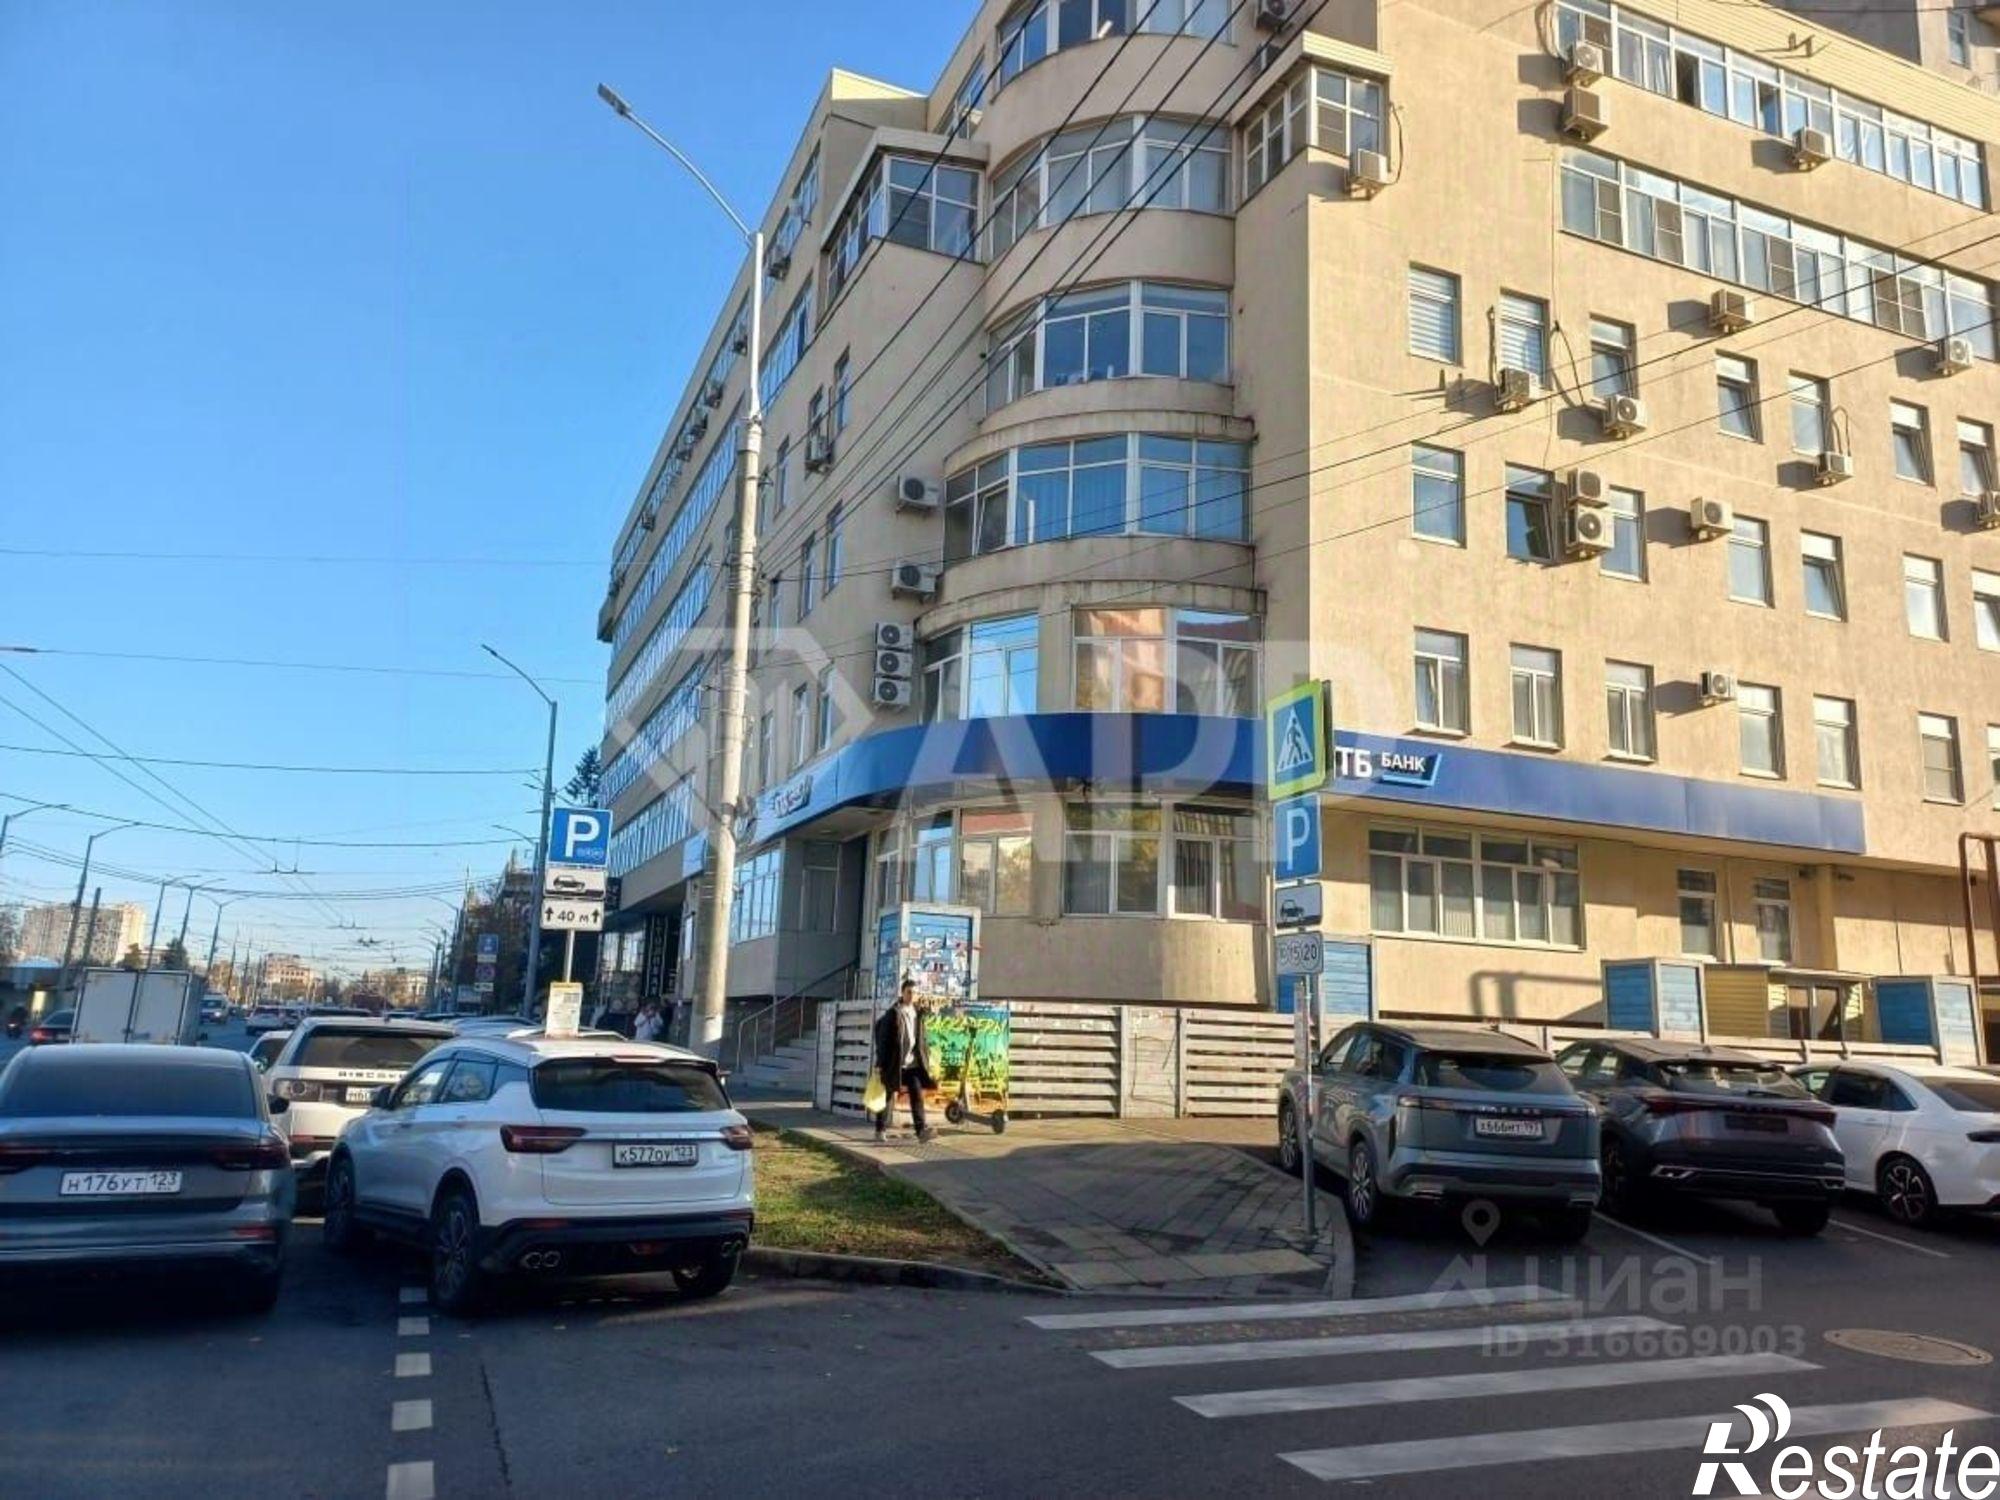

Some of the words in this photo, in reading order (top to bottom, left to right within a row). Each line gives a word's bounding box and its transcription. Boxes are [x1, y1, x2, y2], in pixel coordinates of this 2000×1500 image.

[1335, 745, 1373, 778] ТБ
[1381, 751, 1426, 773] БАНК
[564, 813, 600, 859] P
[1286, 808, 1311, 871] P
[557, 910, 575, 921] 40
[1303, 943, 1318, 961] 20
[67, 1174, 146, 1192] Н176УТ
[149, 1172, 178, 1186] 123
